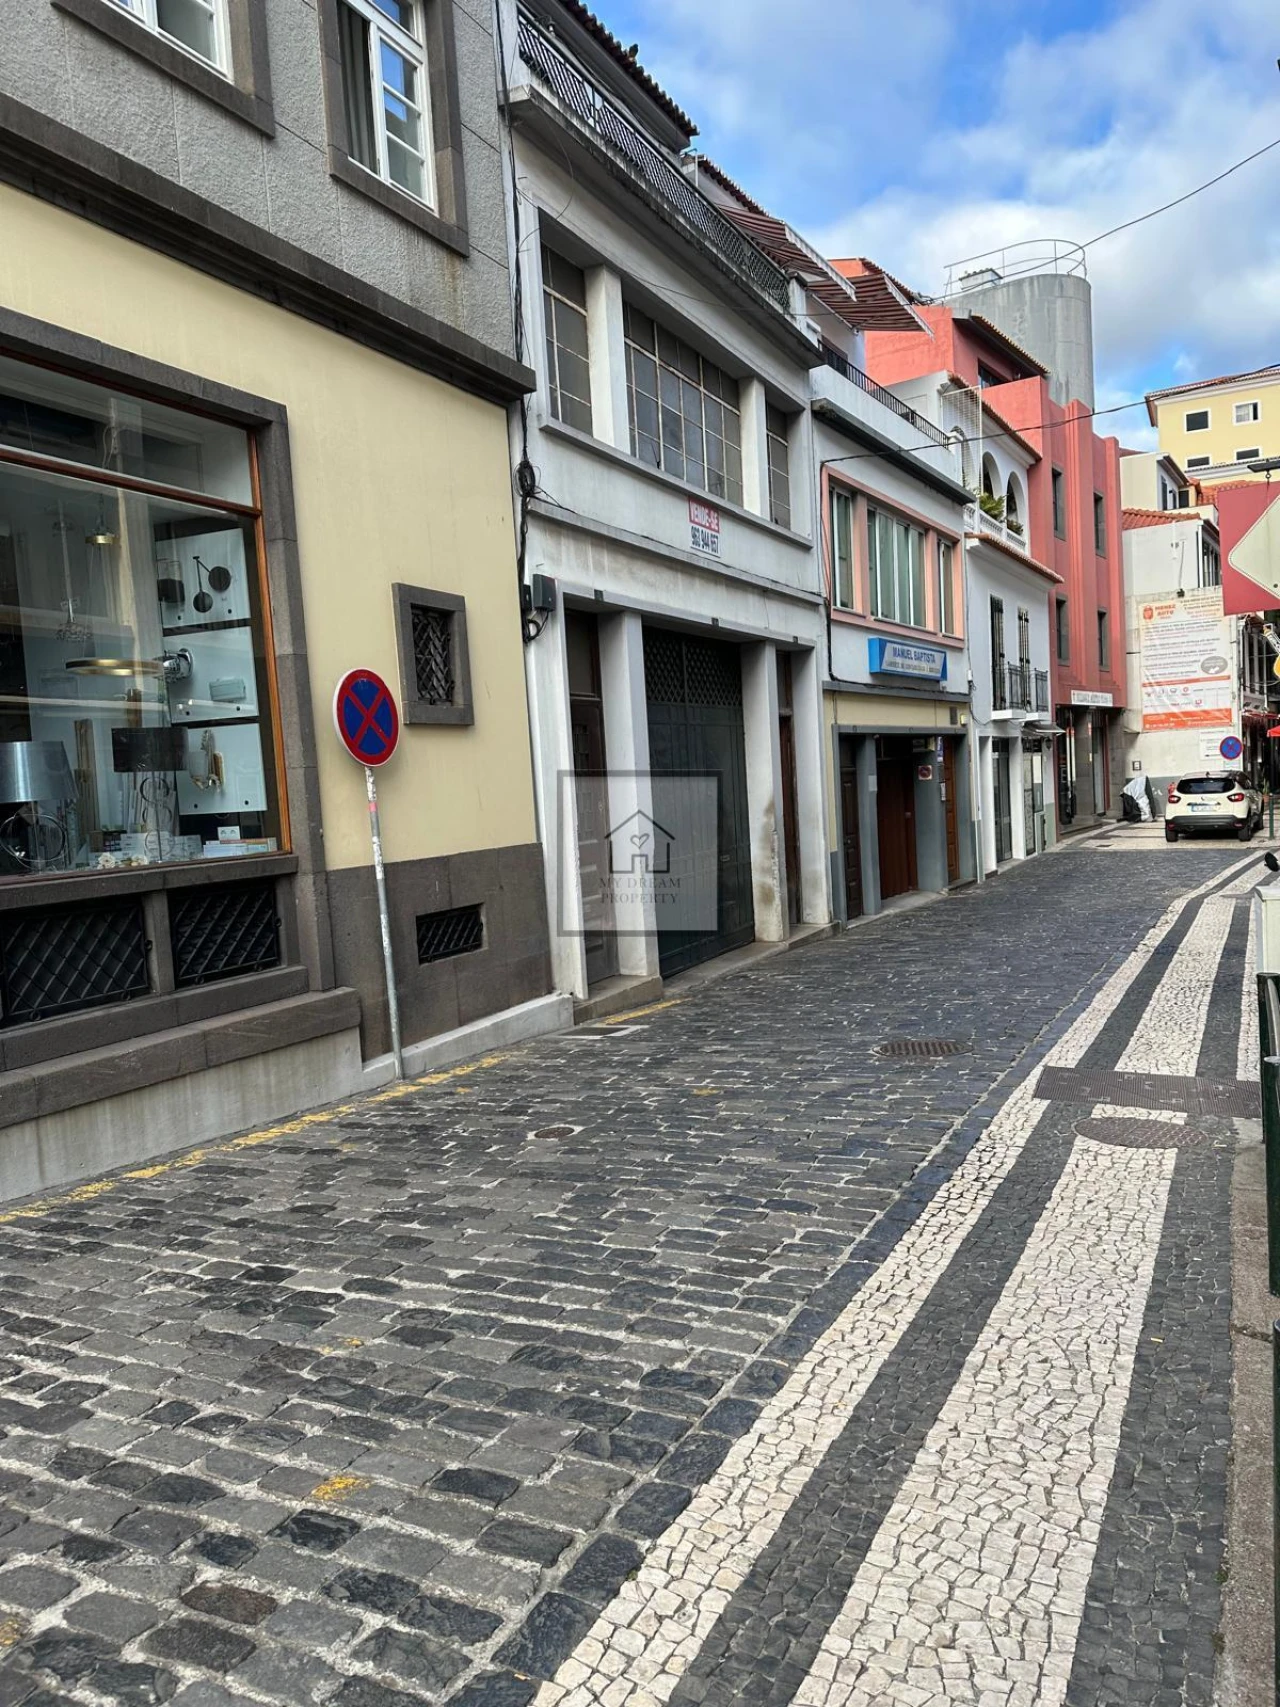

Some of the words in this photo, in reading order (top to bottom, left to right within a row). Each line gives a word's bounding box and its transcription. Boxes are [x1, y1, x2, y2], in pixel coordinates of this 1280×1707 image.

[690, 501, 719, 530] VENDE-SE
[892, 646, 914, 660] MANUEL
[914, 651, 936, 664] BAPTISTA
